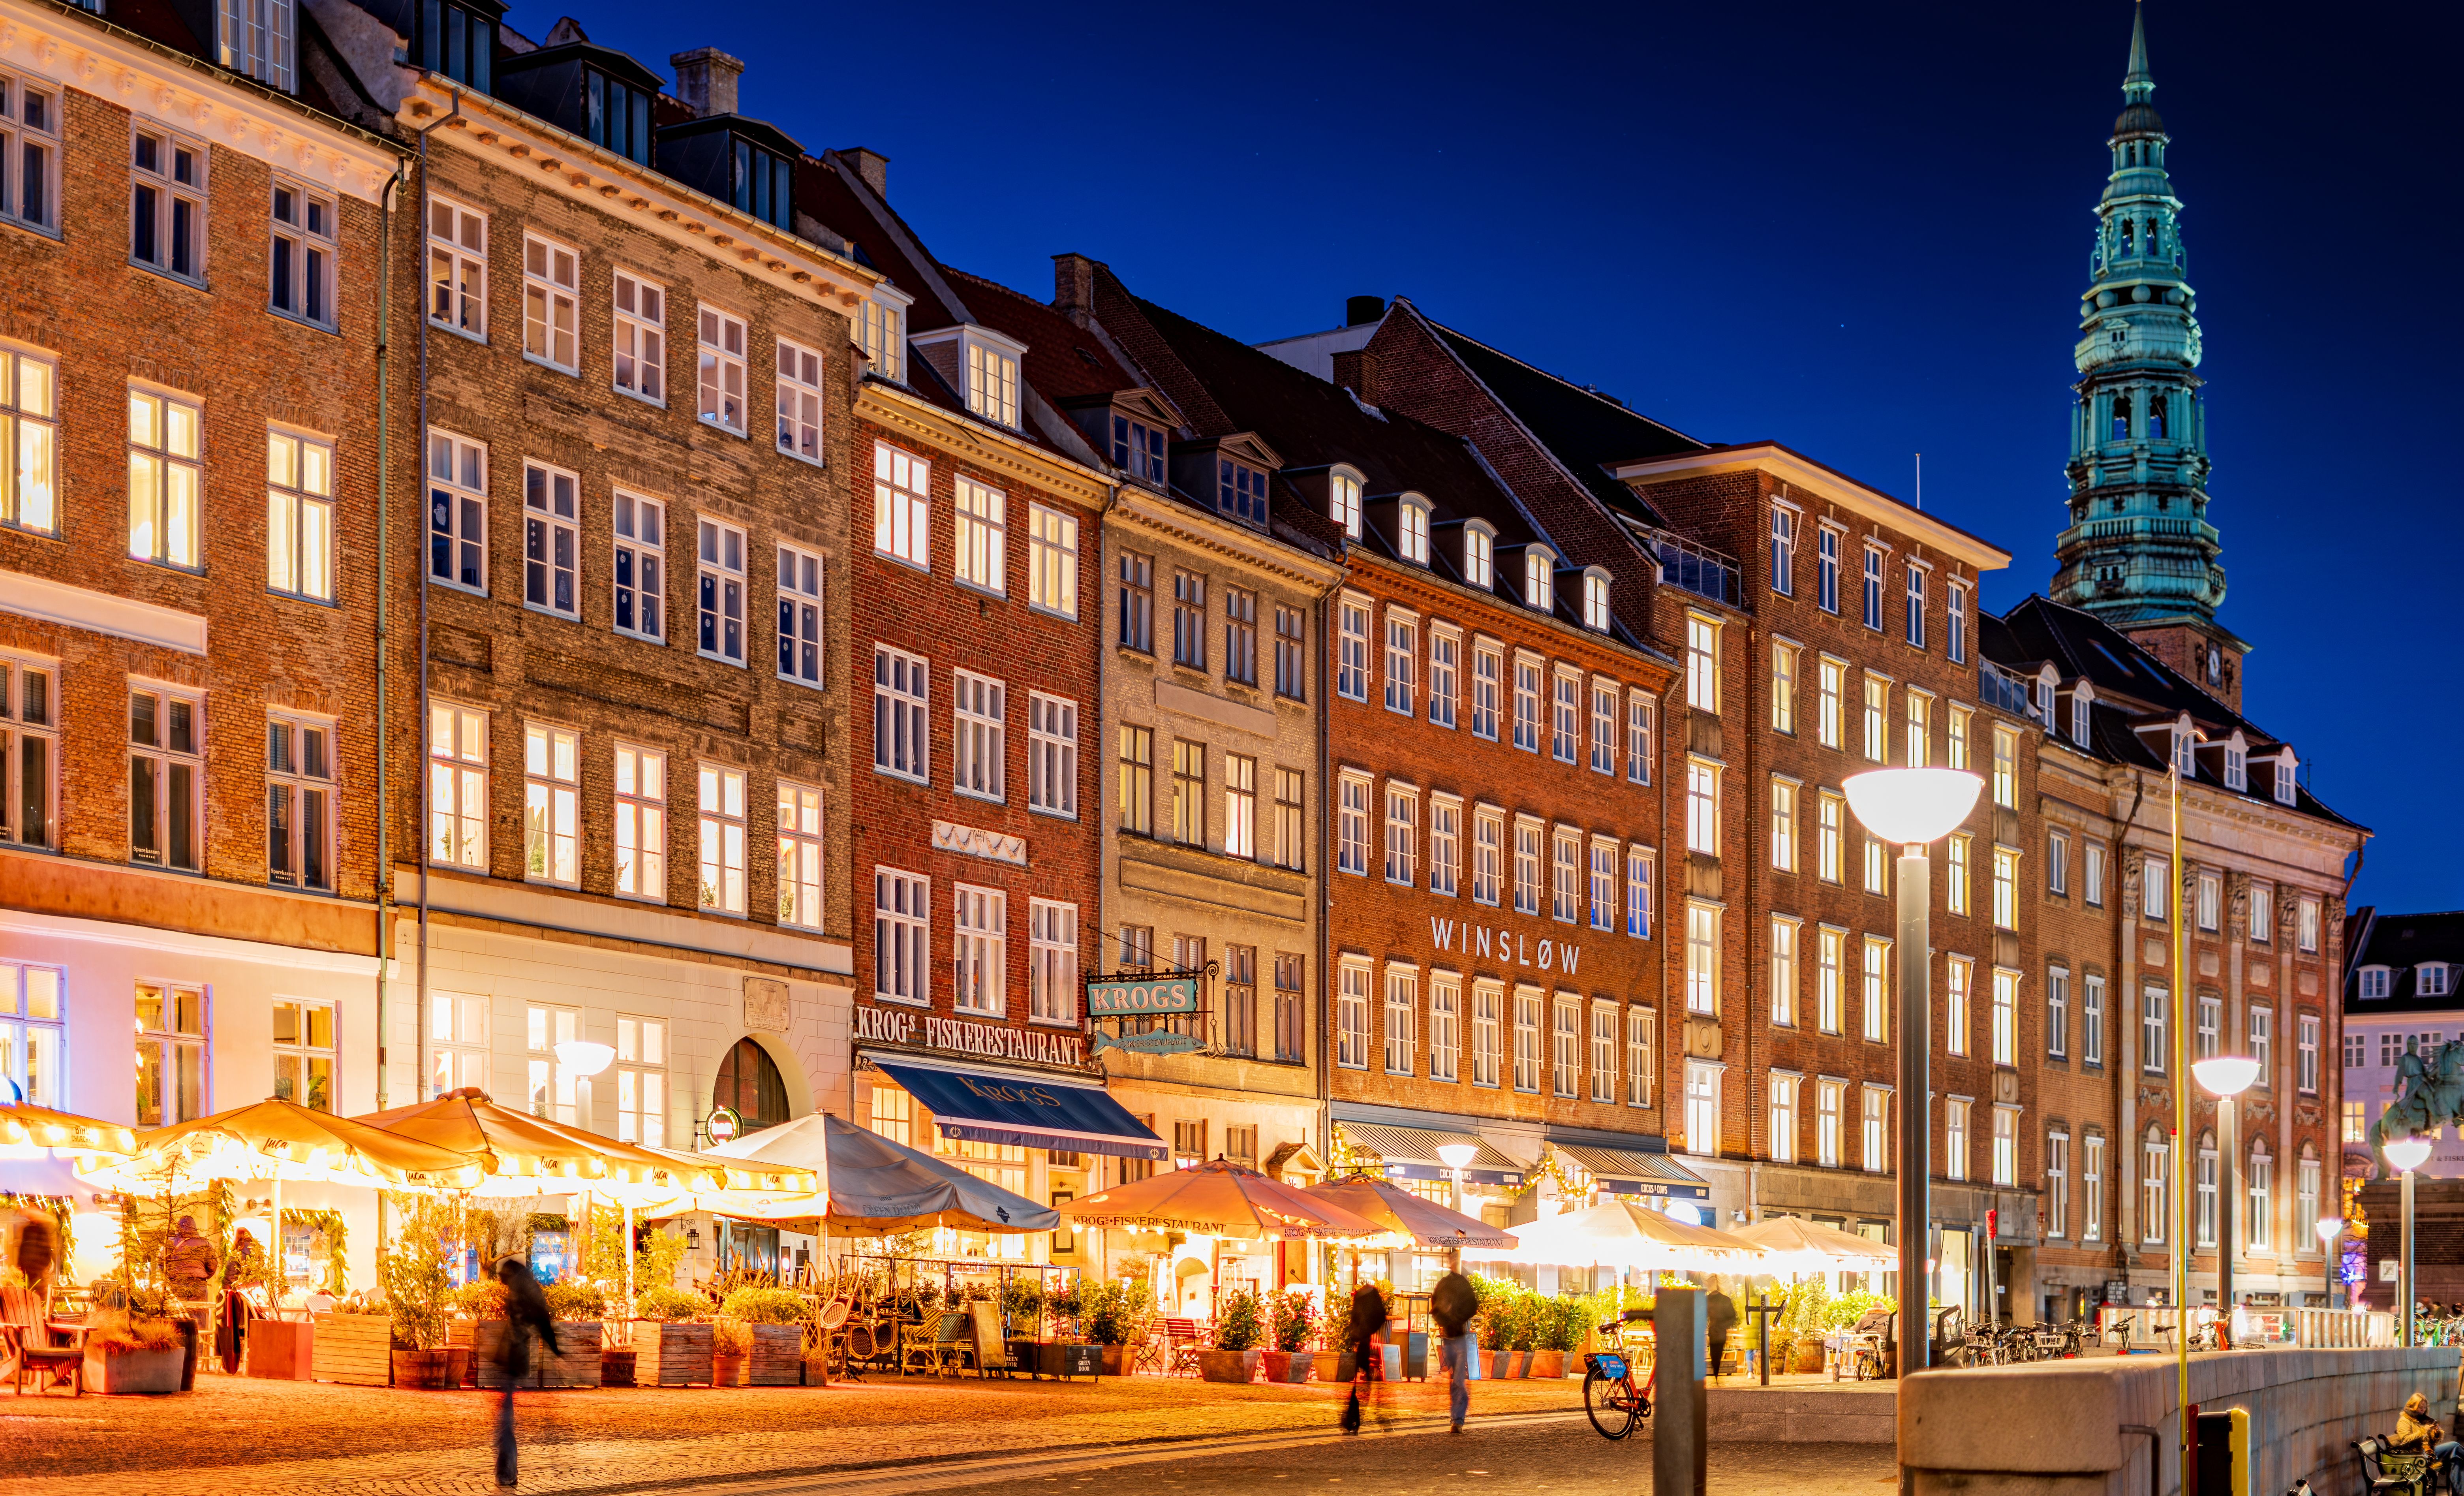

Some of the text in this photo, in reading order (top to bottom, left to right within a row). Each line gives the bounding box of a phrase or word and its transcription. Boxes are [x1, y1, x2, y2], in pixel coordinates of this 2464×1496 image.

[1431, 916, 1579, 975] WINSLØW
[1091, 985, 1186, 1011] KROGS
[924, 1017, 1082, 1066] FISKERESTAURANT
[1117, 1037, 1187, 1048] FISKERESTAURANT
[955, 1077, 1061, 1106] KROGS
[1641, 1184, 1654, 1193] COCKS
[1657, 1185, 1668, 1195] COWS
[862, 1203, 922, 1216] GREEN DOOR
[1113, 1216, 1226, 1233] FISKERESTAURANT
[1448, 1237, 1504, 1247] FISKERESTAURANT
